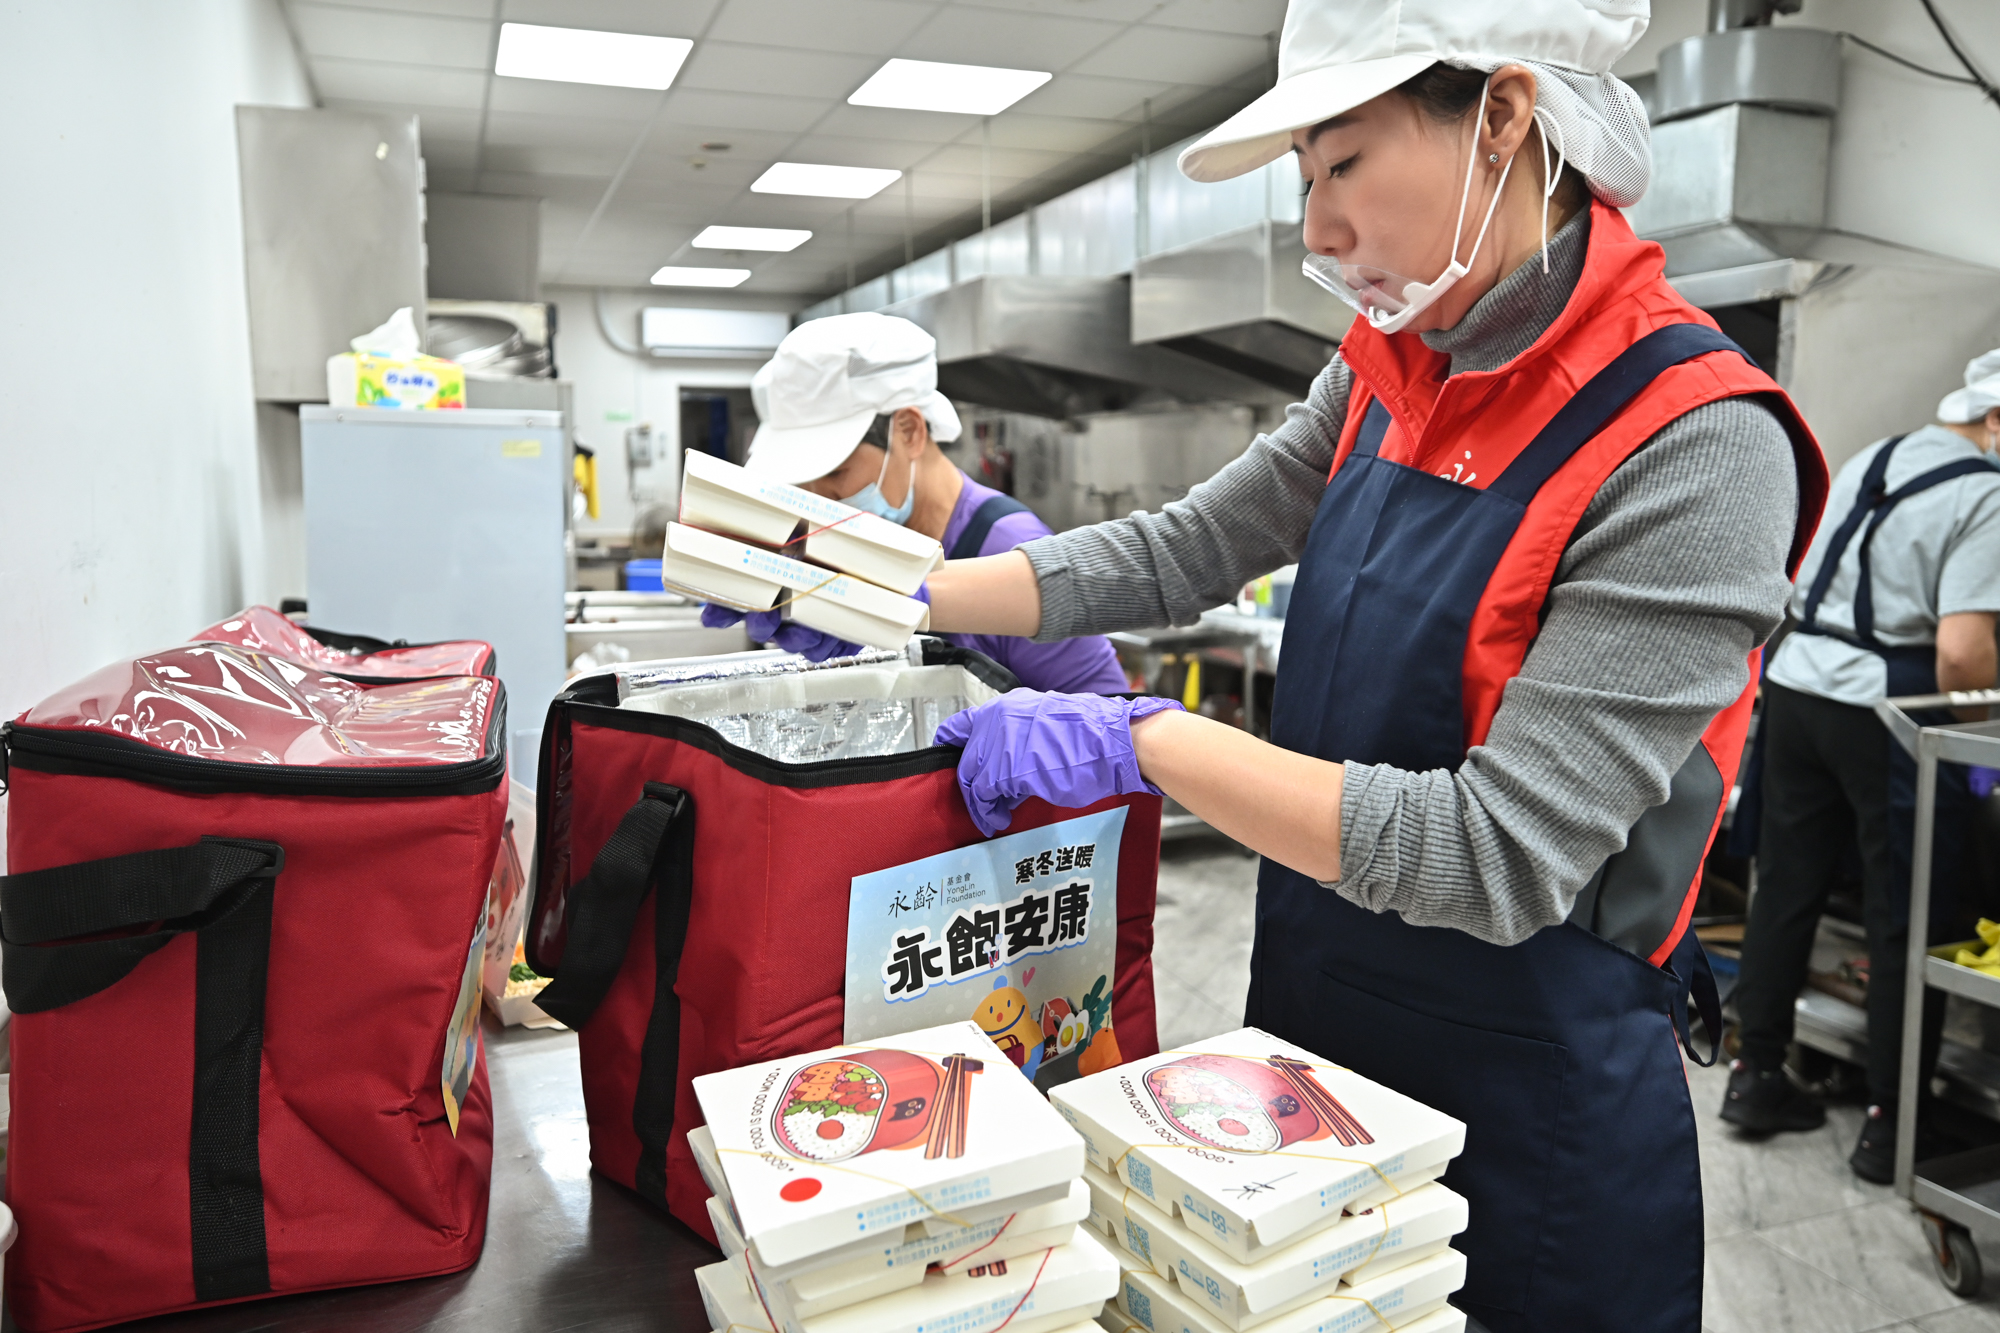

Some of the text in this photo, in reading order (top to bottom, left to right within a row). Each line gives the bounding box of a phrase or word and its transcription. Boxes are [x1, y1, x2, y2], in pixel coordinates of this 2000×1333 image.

[947, 872, 971, 886] 基金會
[1015, 844, 1095, 885] 寒冬送暖
[887, 881, 938, 918] 永齡
[946, 889, 986, 904] Foundation
[947, 882, 976, 895] YongLin
[887, 883, 1090, 994] 永飽安康
[750, 1072, 789, 1170] GOOD FOOD IS GOOD MOOD
[1119, 1079, 1226, 1163] GOOD FOOD IS GOOD MOOD
